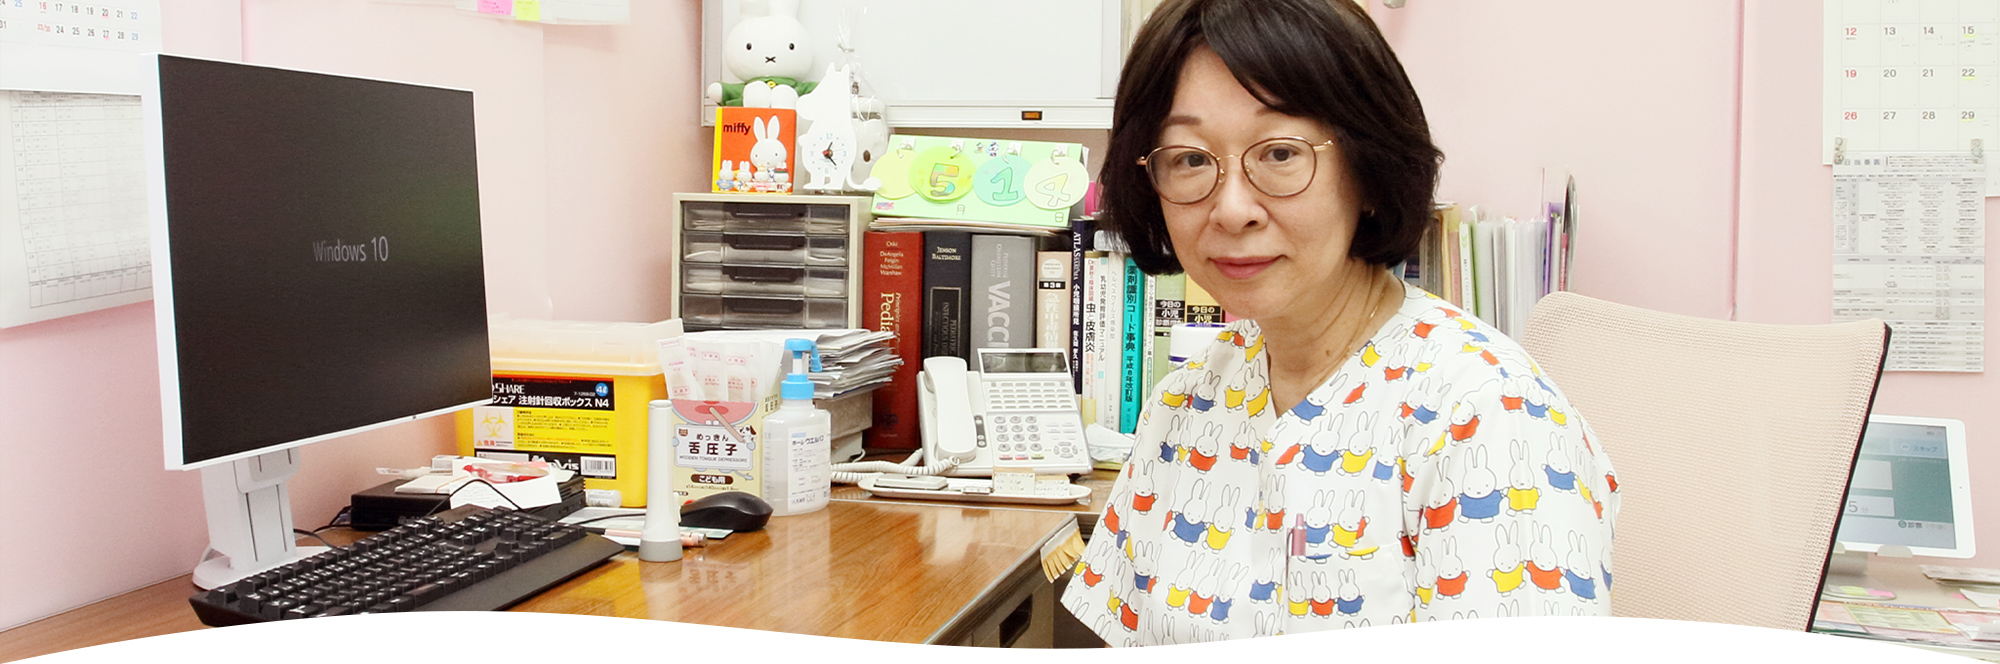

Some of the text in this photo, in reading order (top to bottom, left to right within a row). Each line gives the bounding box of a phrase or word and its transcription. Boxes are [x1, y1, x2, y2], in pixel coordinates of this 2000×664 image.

[39, 2, 138, 20] 16 17 18 19 20 21 22
[56, 25, 64, 34] 24
[72, 27, 80, 35] 25
[87, 28, 95, 37] 26
[103, 30, 109, 38] 27
[117, 31, 124, 39] 28
[131, 33, 138, 41] 29
[1845, 26, 1974, 36] 12 13 14 15
[1845, 68, 1975, 78] 19 20 21 22
[1844, 111, 1975, 120] 26 27 28 29
[723, 122, 751, 136] miffy
[930, 163, 959, 197] 5
[1055, 212, 1064, 223] 日
[312, 236, 389, 262] Windows 10
[1073, 231, 1081, 257] ATLAS
[1125, 265, 1137, 351] 薬剤識別コード事典
[1160, 300, 1181, 308] 今日の
[1161, 308, 1179, 318] 小児
[1192, 306, 1215, 314] 今日の
[1194, 314, 1212, 324] 小児
[1085, 302, 1096, 353] 虫と皮膚炎
[518, 395, 593, 407] 注射針回収ボックス
[594, 398, 609, 408] N4
[696, 433, 729, 442] めっきん
[688, 441, 738, 456] 舌圧子
[1913, 445, 1938, 453] スキップ
[699, 475, 726, 484] こども用
[1848, 501, 1858, 513] 5
